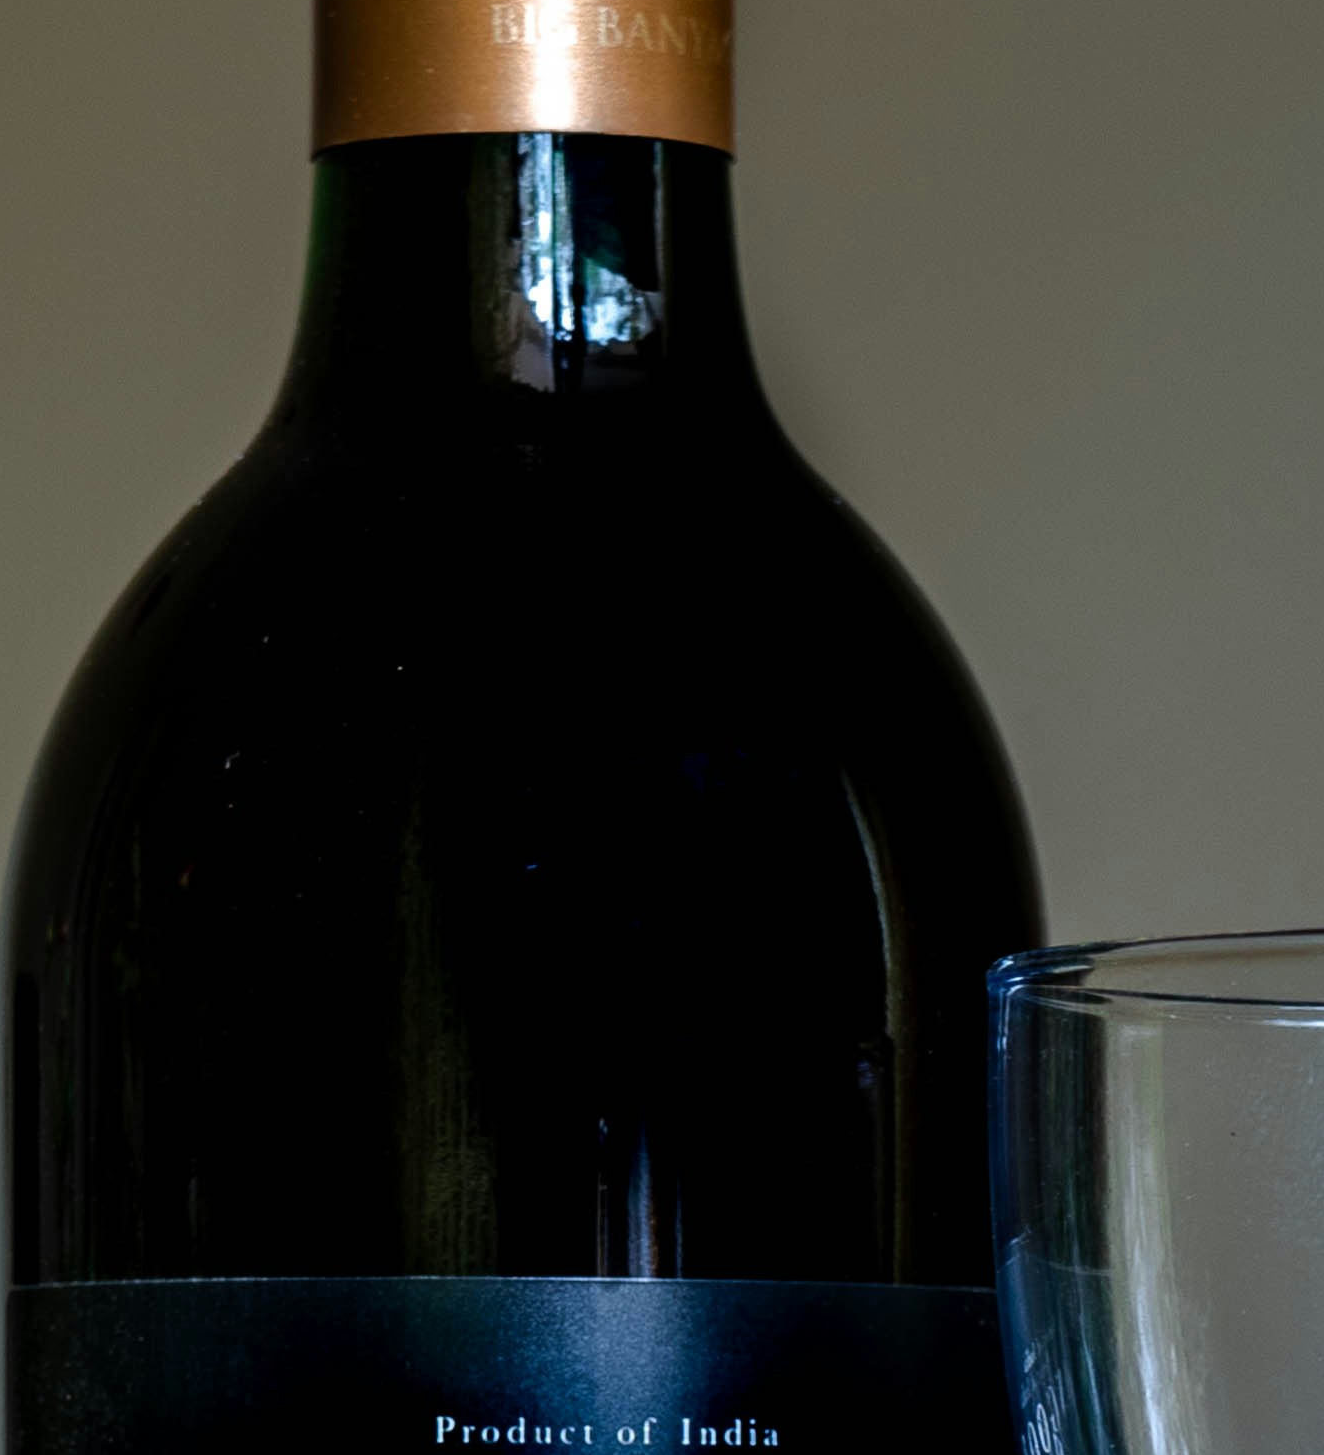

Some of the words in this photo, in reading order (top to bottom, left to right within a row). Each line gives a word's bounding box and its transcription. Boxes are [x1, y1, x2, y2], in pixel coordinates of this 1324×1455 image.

[435, 1415, 594, 1446] Product
[616, 1416, 658, 1446] of
[680, 1417, 780, 1447] India
